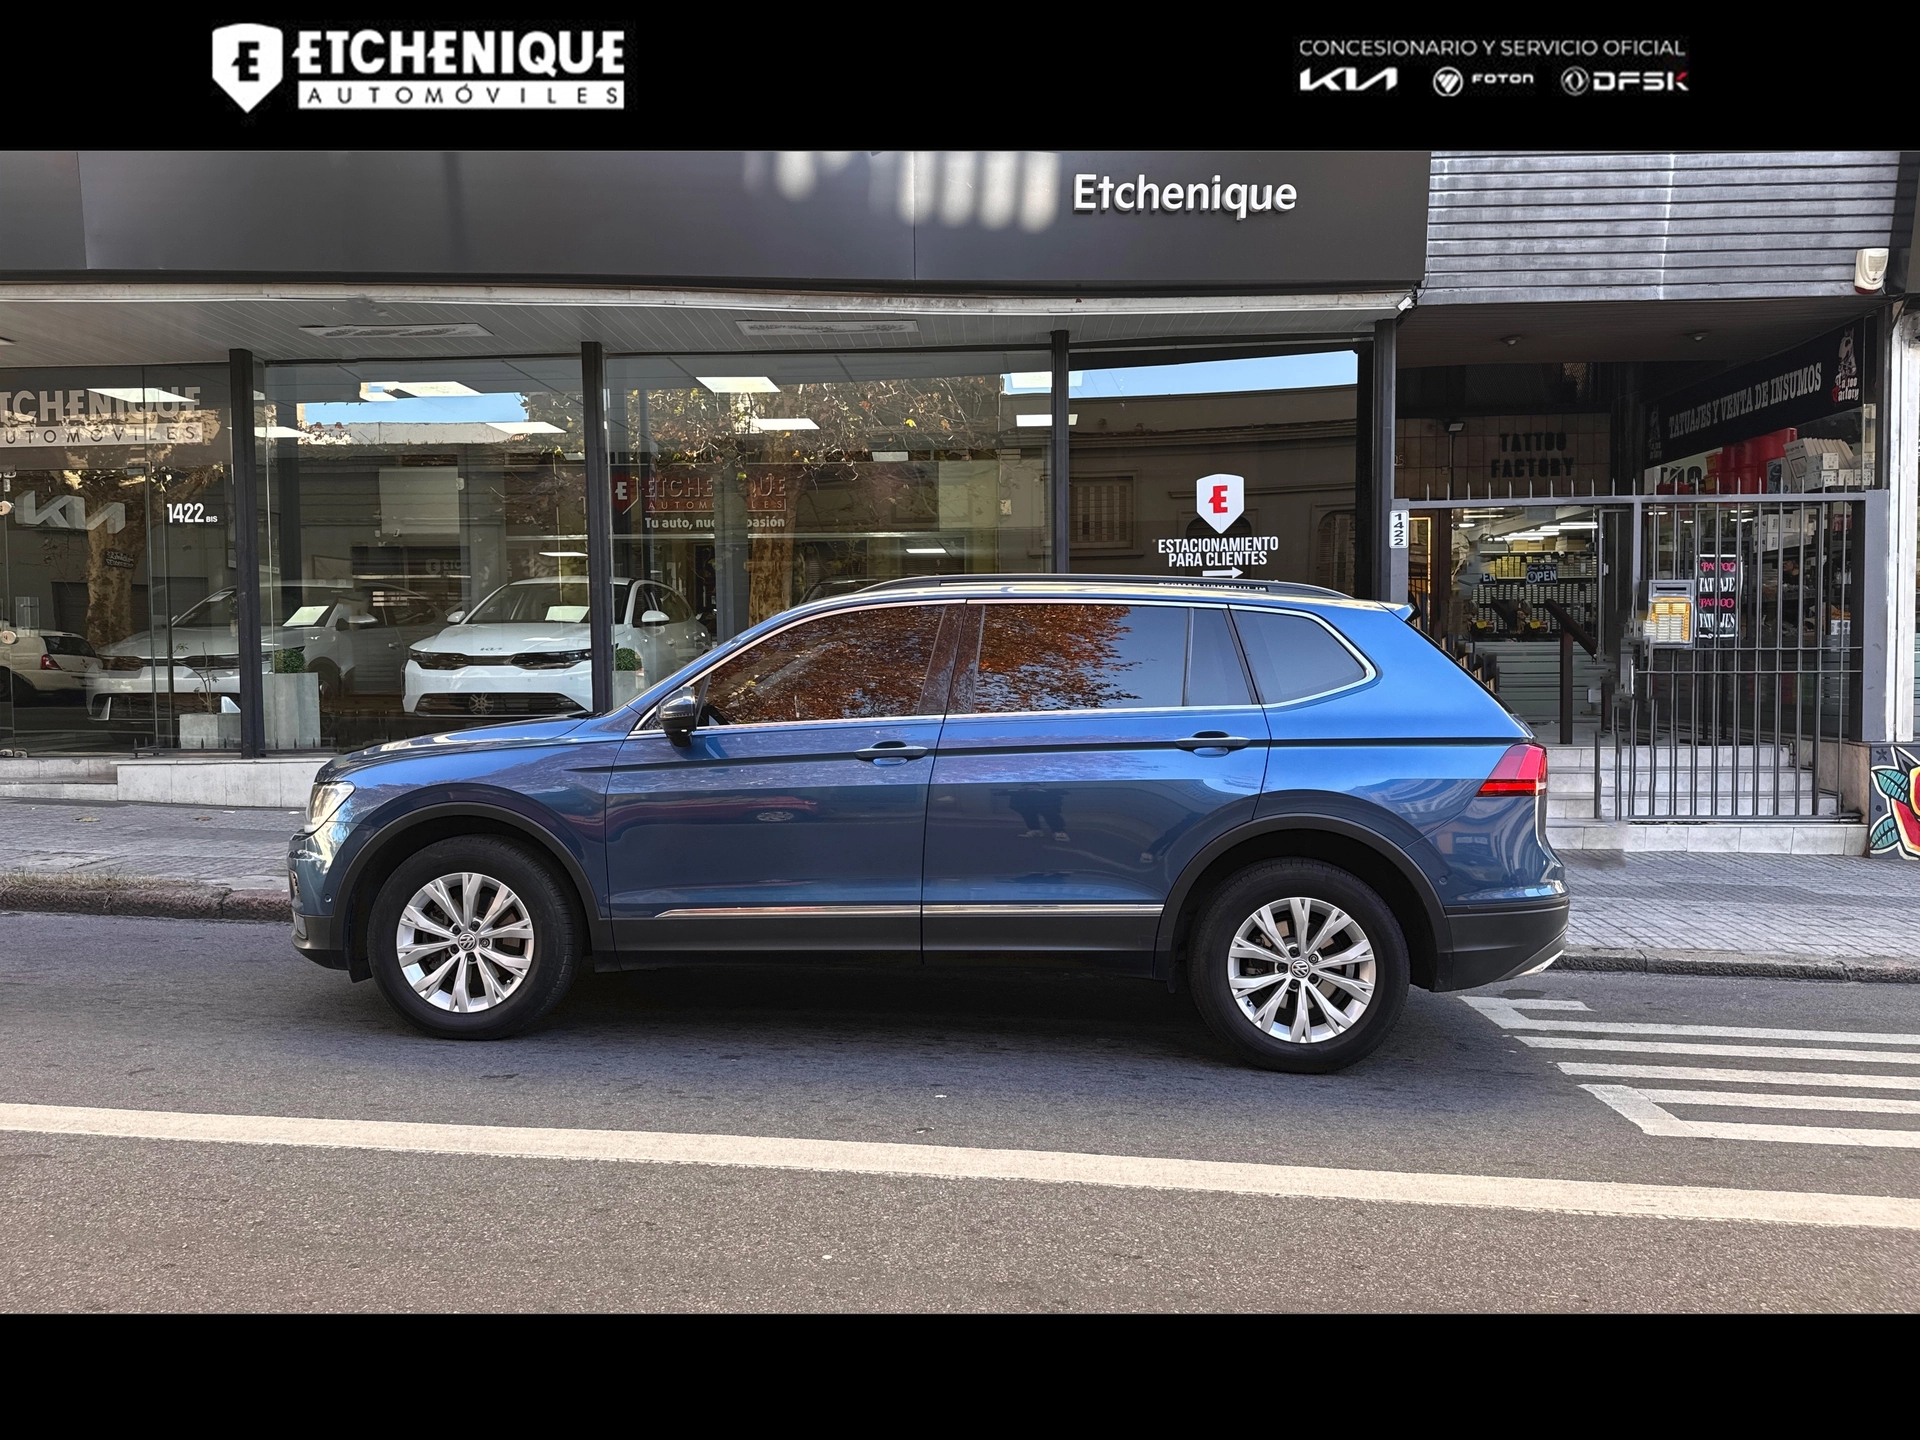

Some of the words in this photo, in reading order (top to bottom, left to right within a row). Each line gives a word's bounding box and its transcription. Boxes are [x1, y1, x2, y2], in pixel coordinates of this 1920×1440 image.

[1073, 172, 1298, 221] Etchenique
[1668, 401, 1712, 439] TATUAJES
[1712, 399, 1720, 424] Y
[1720, 386, 1753, 422] VENTA
[1754, 379, 1769, 410] DE
[1769, 361, 1822, 404] INSUMOS
[1499, 431, 1567, 453] TATTOO
[1490, 456, 1575, 479] FACTORY
[15, 490, 126, 534] KIA
[167, 503, 205, 523] 1422
[205, 515, 218, 523] BIS
[645, 517, 660, 529] Tu
[662, 518, 693, 531] auto,
[1393, 512, 1405, 546] 1422
[1158, 536, 1279, 554] ESTACIONAMIENTO
[1168, 552, 1203, 567] PARA
[1206, 550, 1268, 567] CLIENTES
[1526, 570, 1557, 583] OPEN
